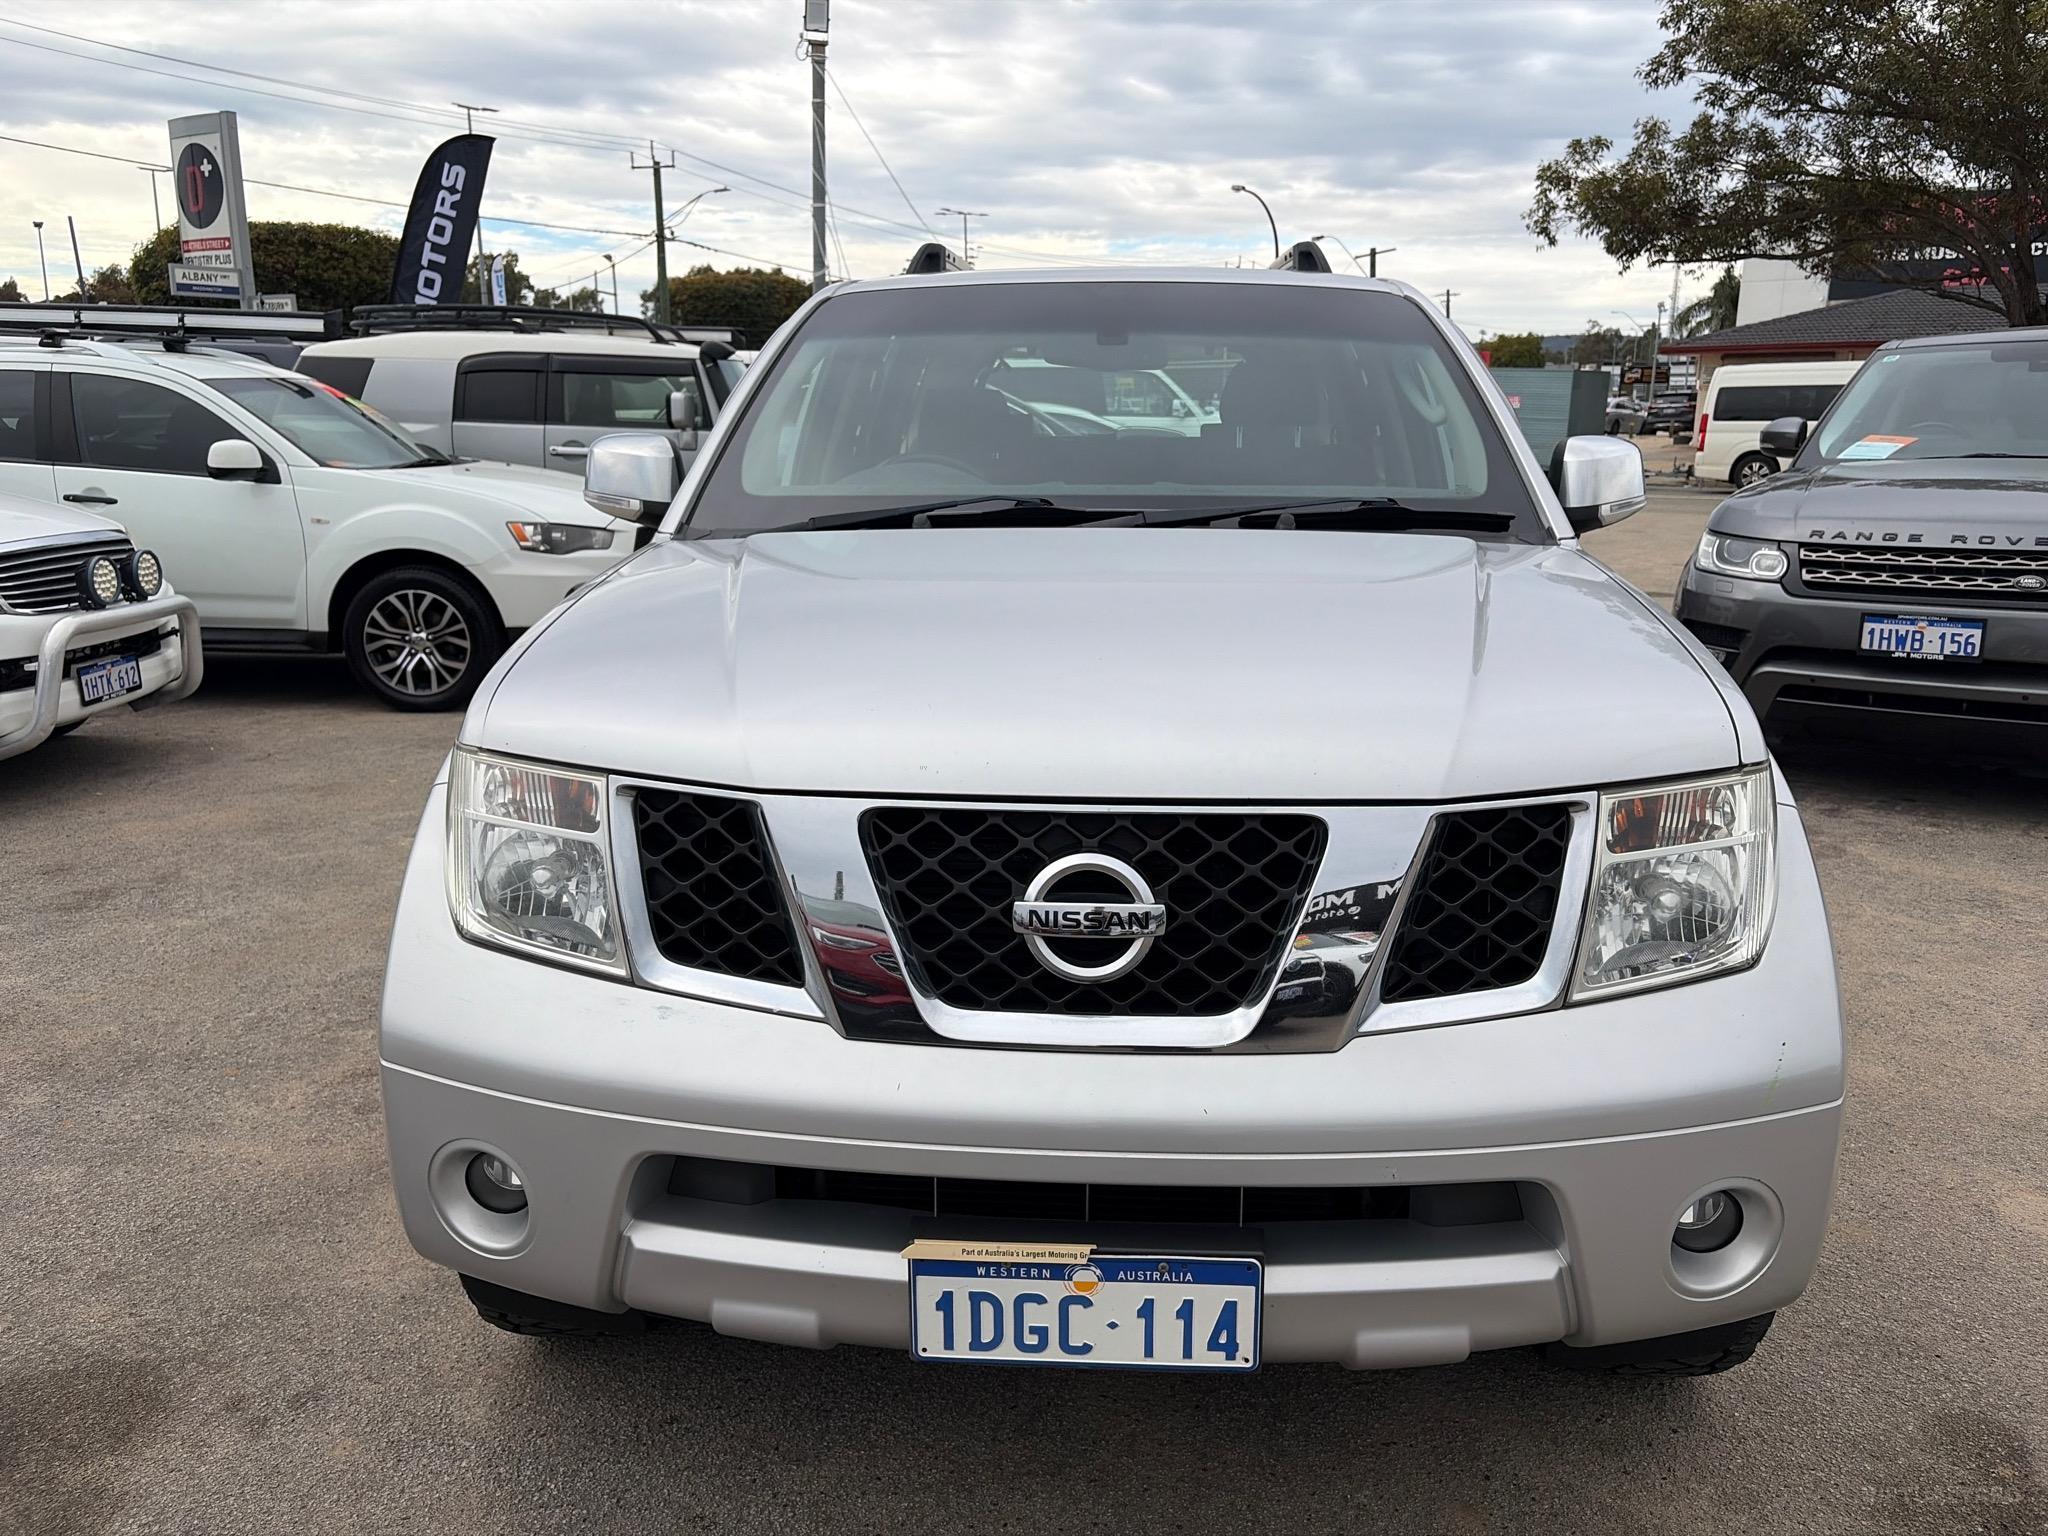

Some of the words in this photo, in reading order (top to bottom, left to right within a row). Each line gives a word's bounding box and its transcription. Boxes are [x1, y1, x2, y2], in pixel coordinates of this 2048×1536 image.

[214, 253, 232, 265] PLUS
[181, 271, 219, 283] ALBANY
[1809, 529, 1924, 543] RANGE
[1950, 534, 2048, 547] ROVE
[1028, 909, 1150, 930] NISSAN
[961, 1248, 976, 1256] Part
[976, 1248, 983, 1256] of
[984, 1248, 1020, 1257] Australia's
[1021, 1250, 1047, 1259] Largest
[1048, 1251, 1078, 1260] Motoring
[976, 1266, 1051, 1279] WESTERN
[1117, 1270, 1194, 1283] AUSTRALIA
